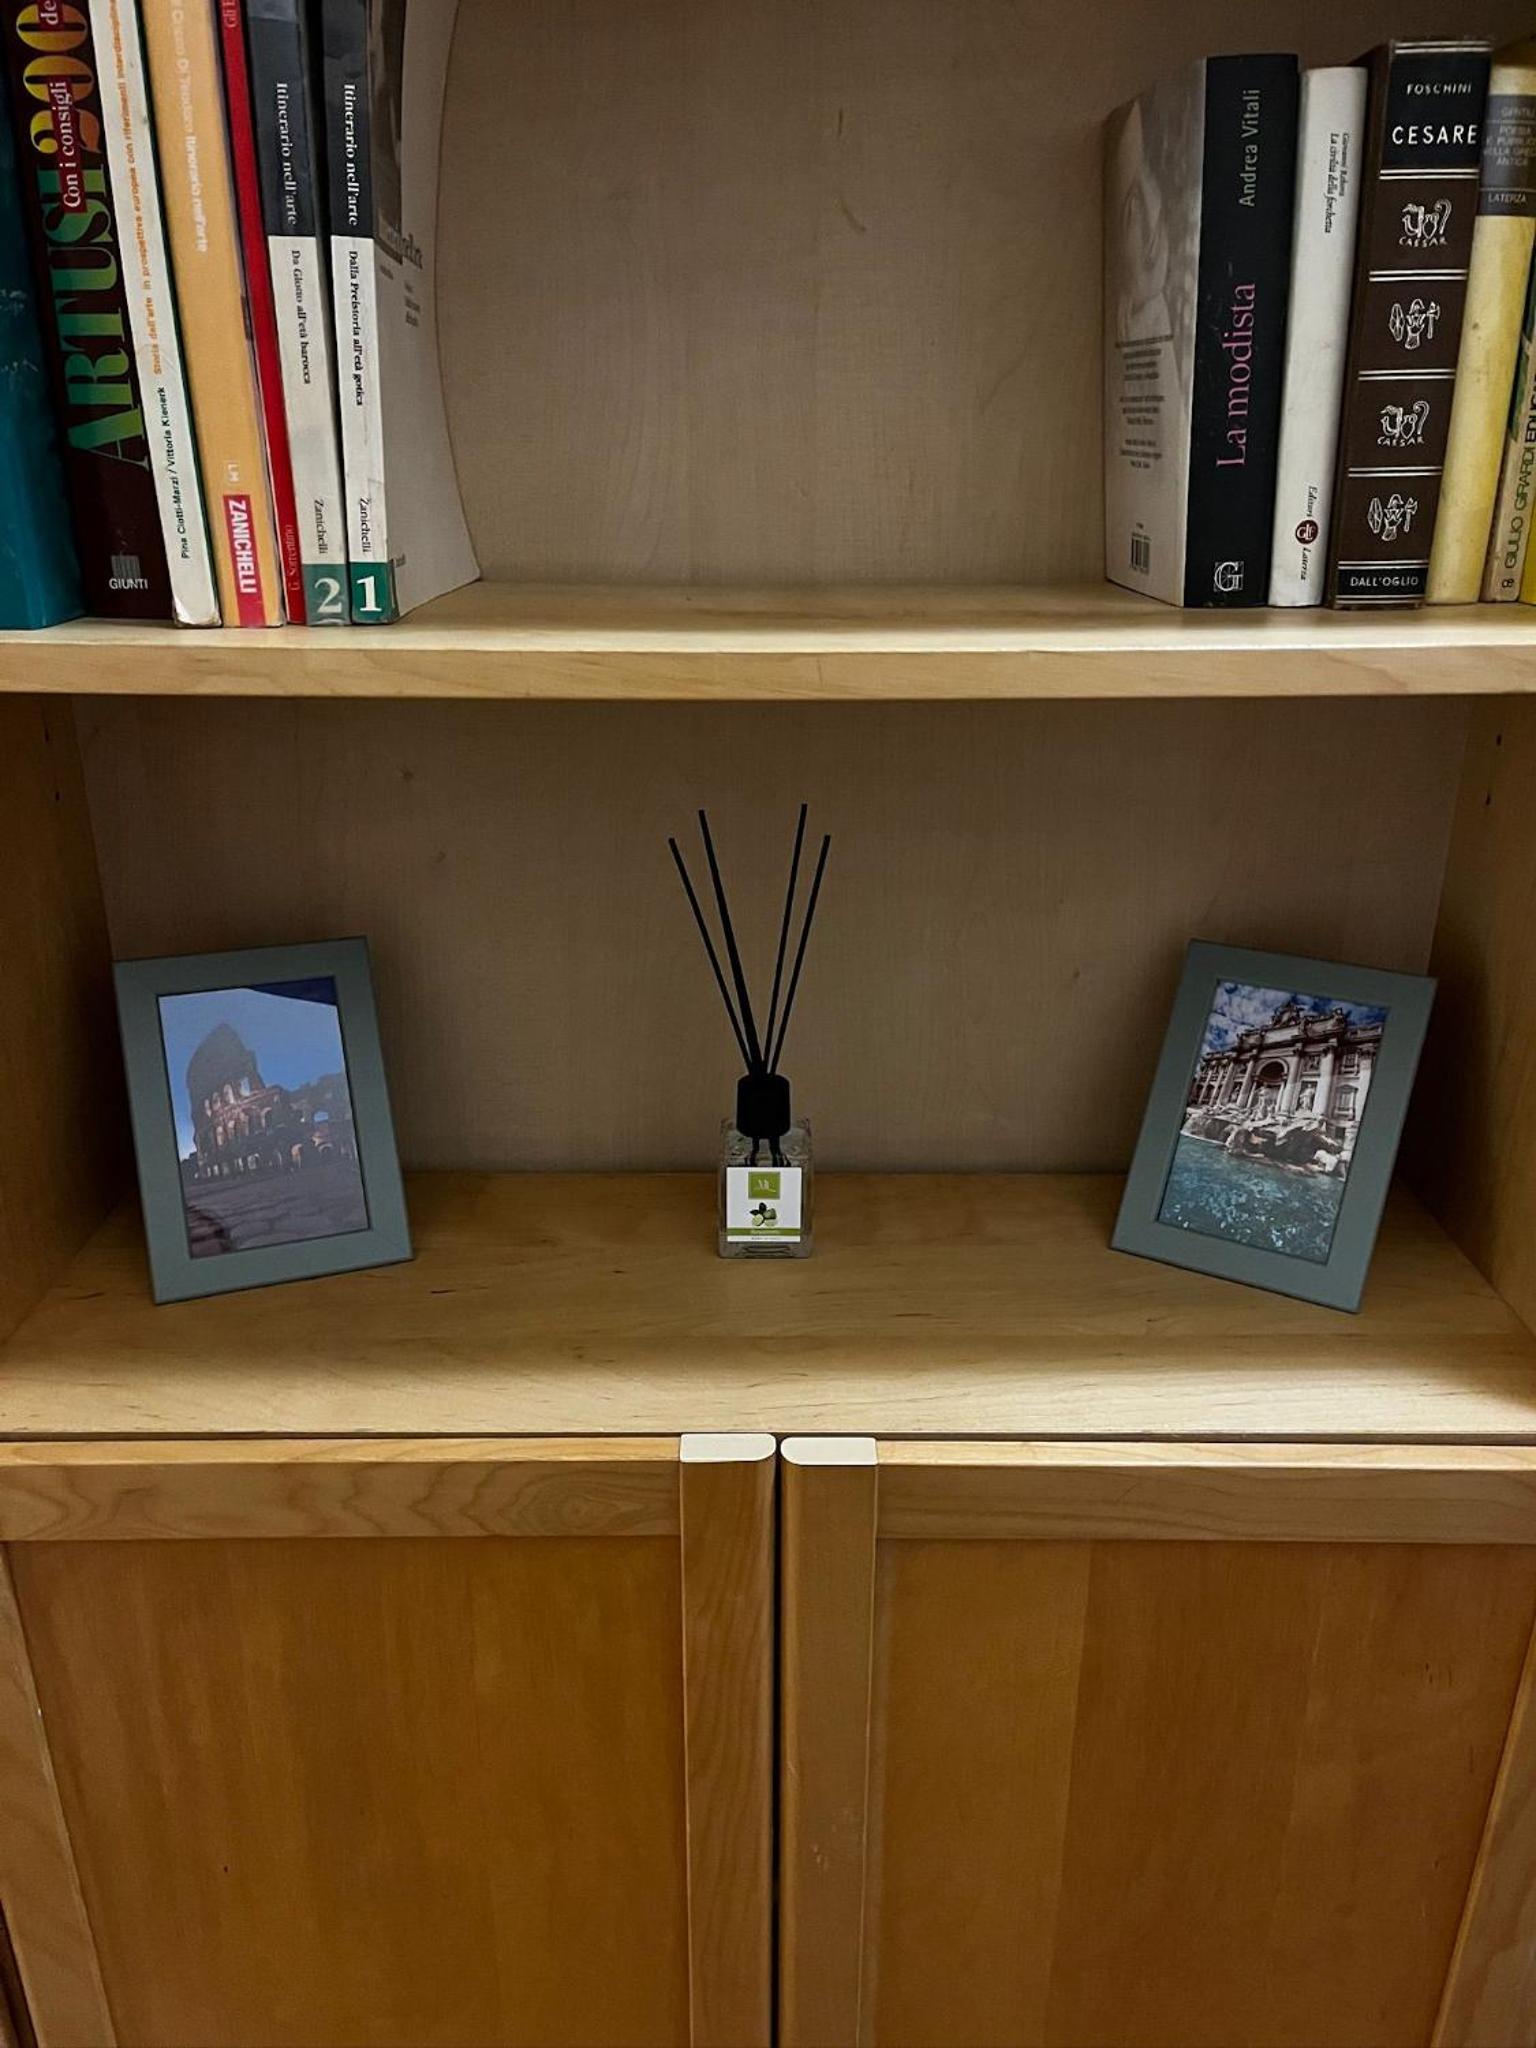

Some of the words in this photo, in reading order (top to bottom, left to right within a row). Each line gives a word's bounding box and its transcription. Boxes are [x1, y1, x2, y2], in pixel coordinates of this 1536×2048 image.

[1406, 82, 1473, 95] FOSCHINI
[50, 81, 74, 156] consigli
[277, 82, 293, 157] Itinerario
[344, 84, 357, 158] Itinerario
[1241, 89, 1260, 138] Vitali
[125, 143, 135, 164] con
[1392, 125, 1478, 145] CESARE
[64, 174, 81, 208] Con
[128, 166, 143, 213] europea
[283, 162, 297, 225] nell'arte
[346, 163, 360, 226] nell'arte
[1238, 144, 1258, 207] Andrea
[1488, 193, 1526, 203] LATERZA
[135, 216, 152, 277] prospettiva
[291, 250, 301, 265] Da
[1399, 236, 1447, 247] CAESAR
[349, 251, 359, 280] Dalla
[144, 280, 153, 290] in
[293, 268, 303, 303] Giotto
[146, 297, 158, 340] dell'arte
[350, 283, 360, 336] Preistoria
[151, 343, 162, 375] Storia
[300, 341, 311, 384] barocca
[353, 339, 363, 371] all'età
[1222, 283, 1256, 418] modista
[159, 387, 171, 427] Kienerk
[353, 373, 364, 406] gotica
[163, 429, 176, 467] Vittoria
[1216, 428, 1247, 467] La
[1377, 437, 1424, 447] CAESAR
[314, 499, 328, 554] Zanichelli
[360, 497, 371, 553] Zanichelli
[1505, 517, 1524, 568] GIULIO
[1515, 447, 1535, 511] GIRARDI
[181, 537, 191, 559] Pina
[228, 499, 257, 594] ZANICHELLI
[108, 578, 148, 590] GIUNTI
[314, 577, 343, 614] 2
[357, 575, 382, 612] 1
[1350, 577, 1419, 587] DALL'OGLIO
